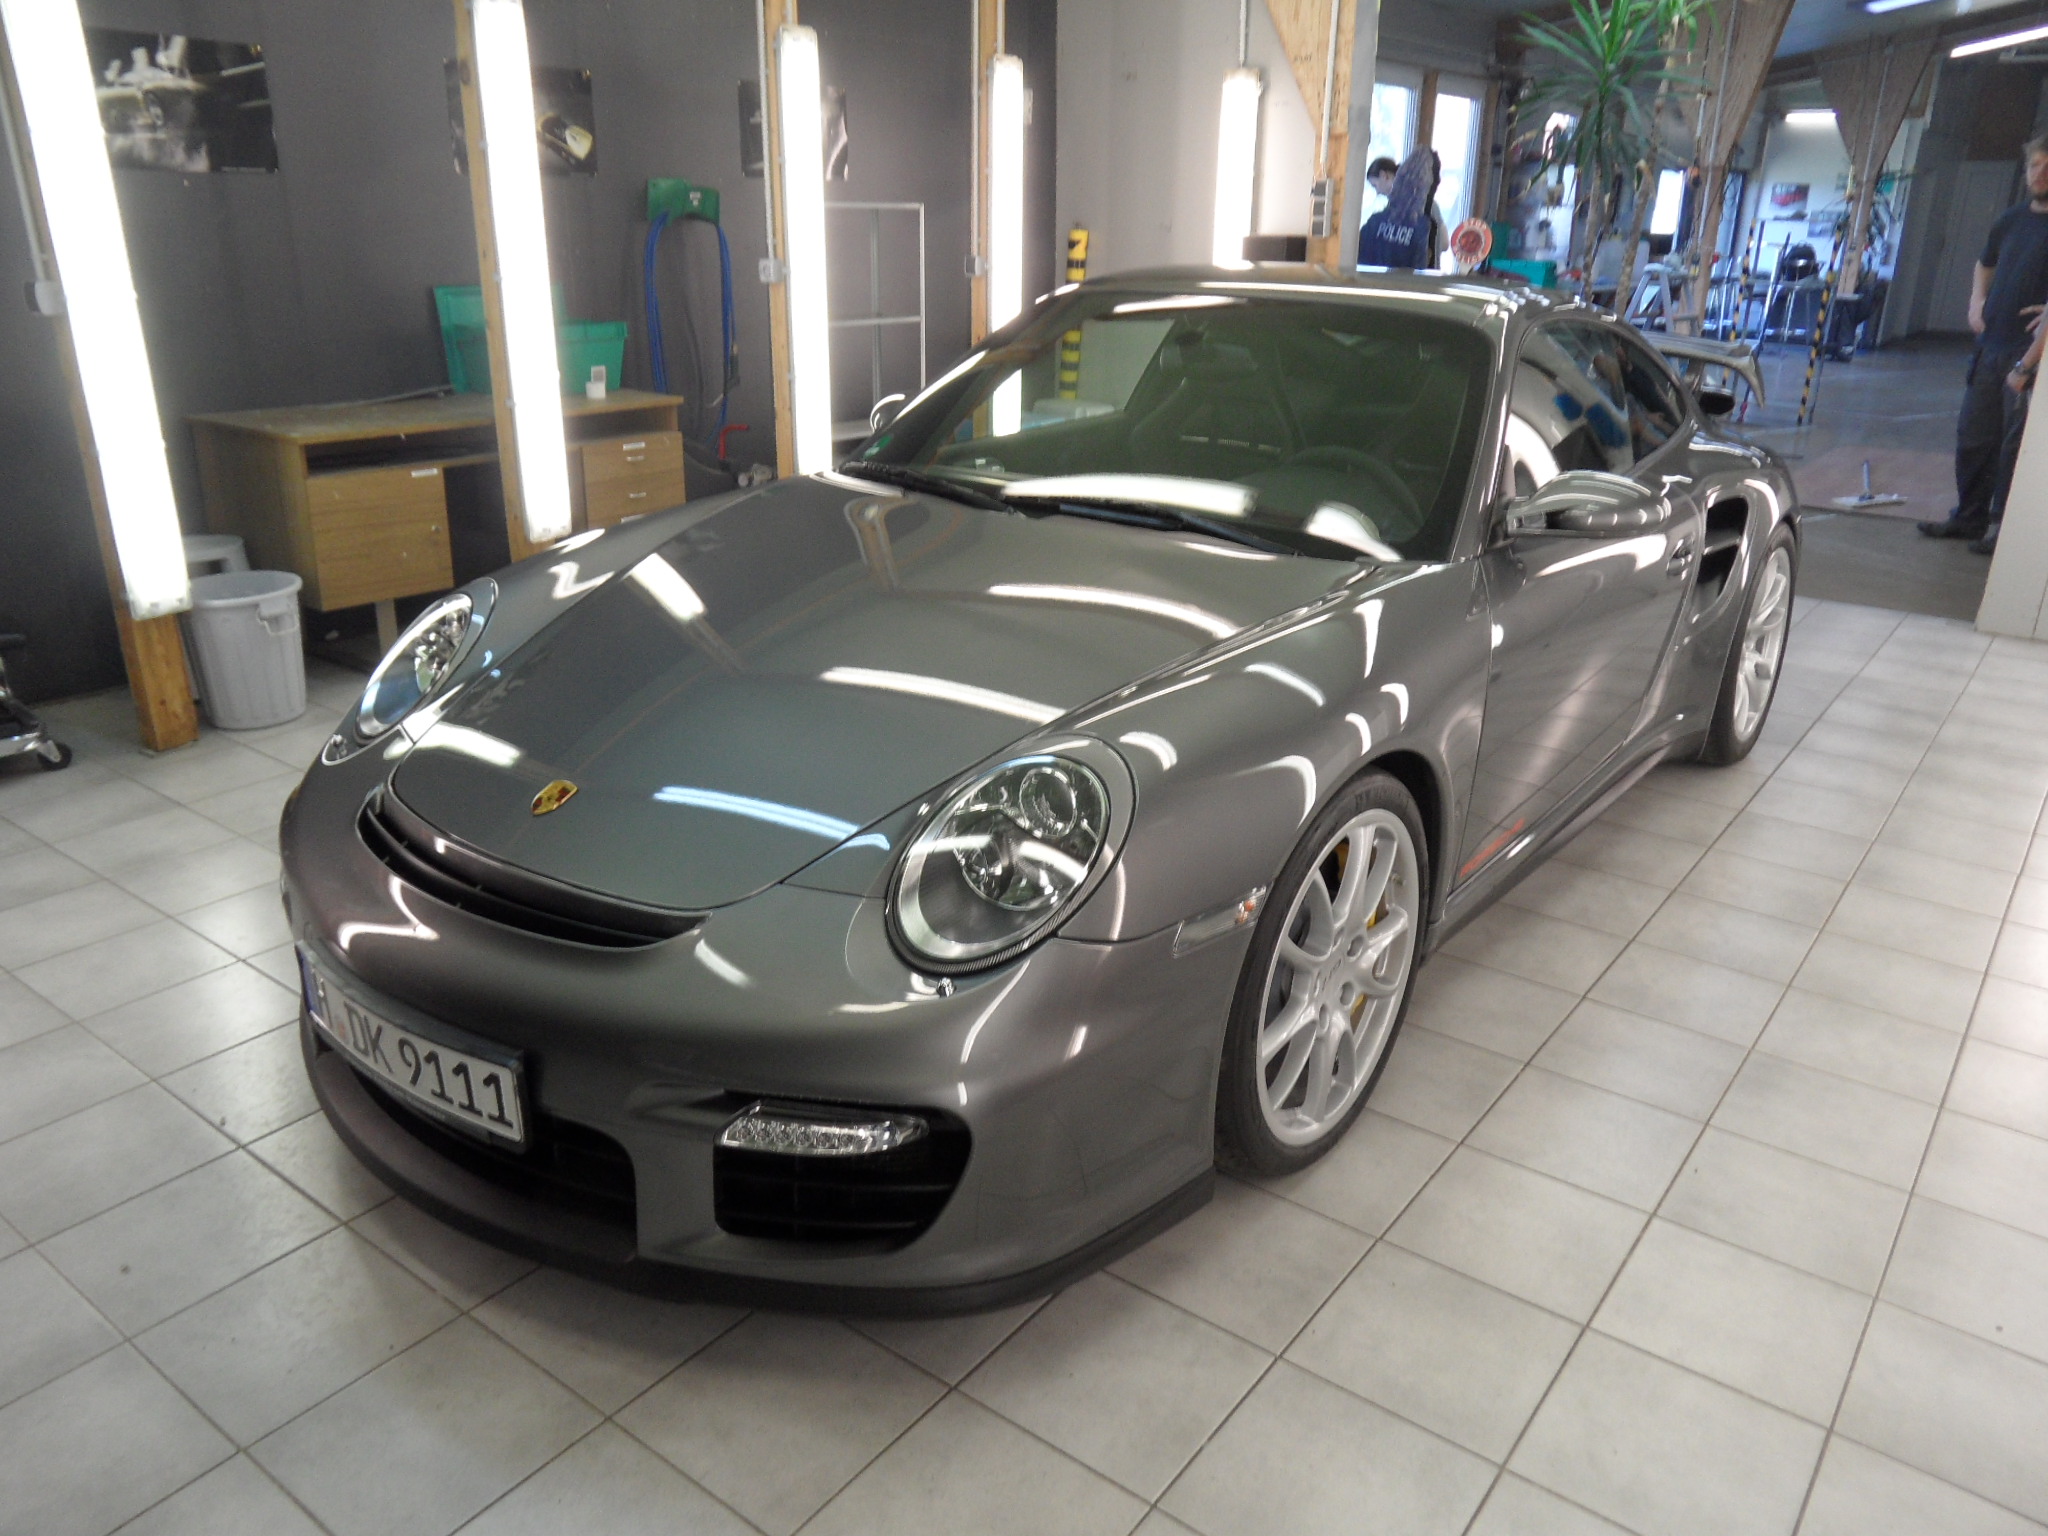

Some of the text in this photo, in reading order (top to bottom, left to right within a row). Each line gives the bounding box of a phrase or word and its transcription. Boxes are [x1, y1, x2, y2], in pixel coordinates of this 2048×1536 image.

[1376, 222, 1414, 246] POLICE
[344, 1000, 394, 1074] DK
[398, 1037, 514, 1129] 9111
